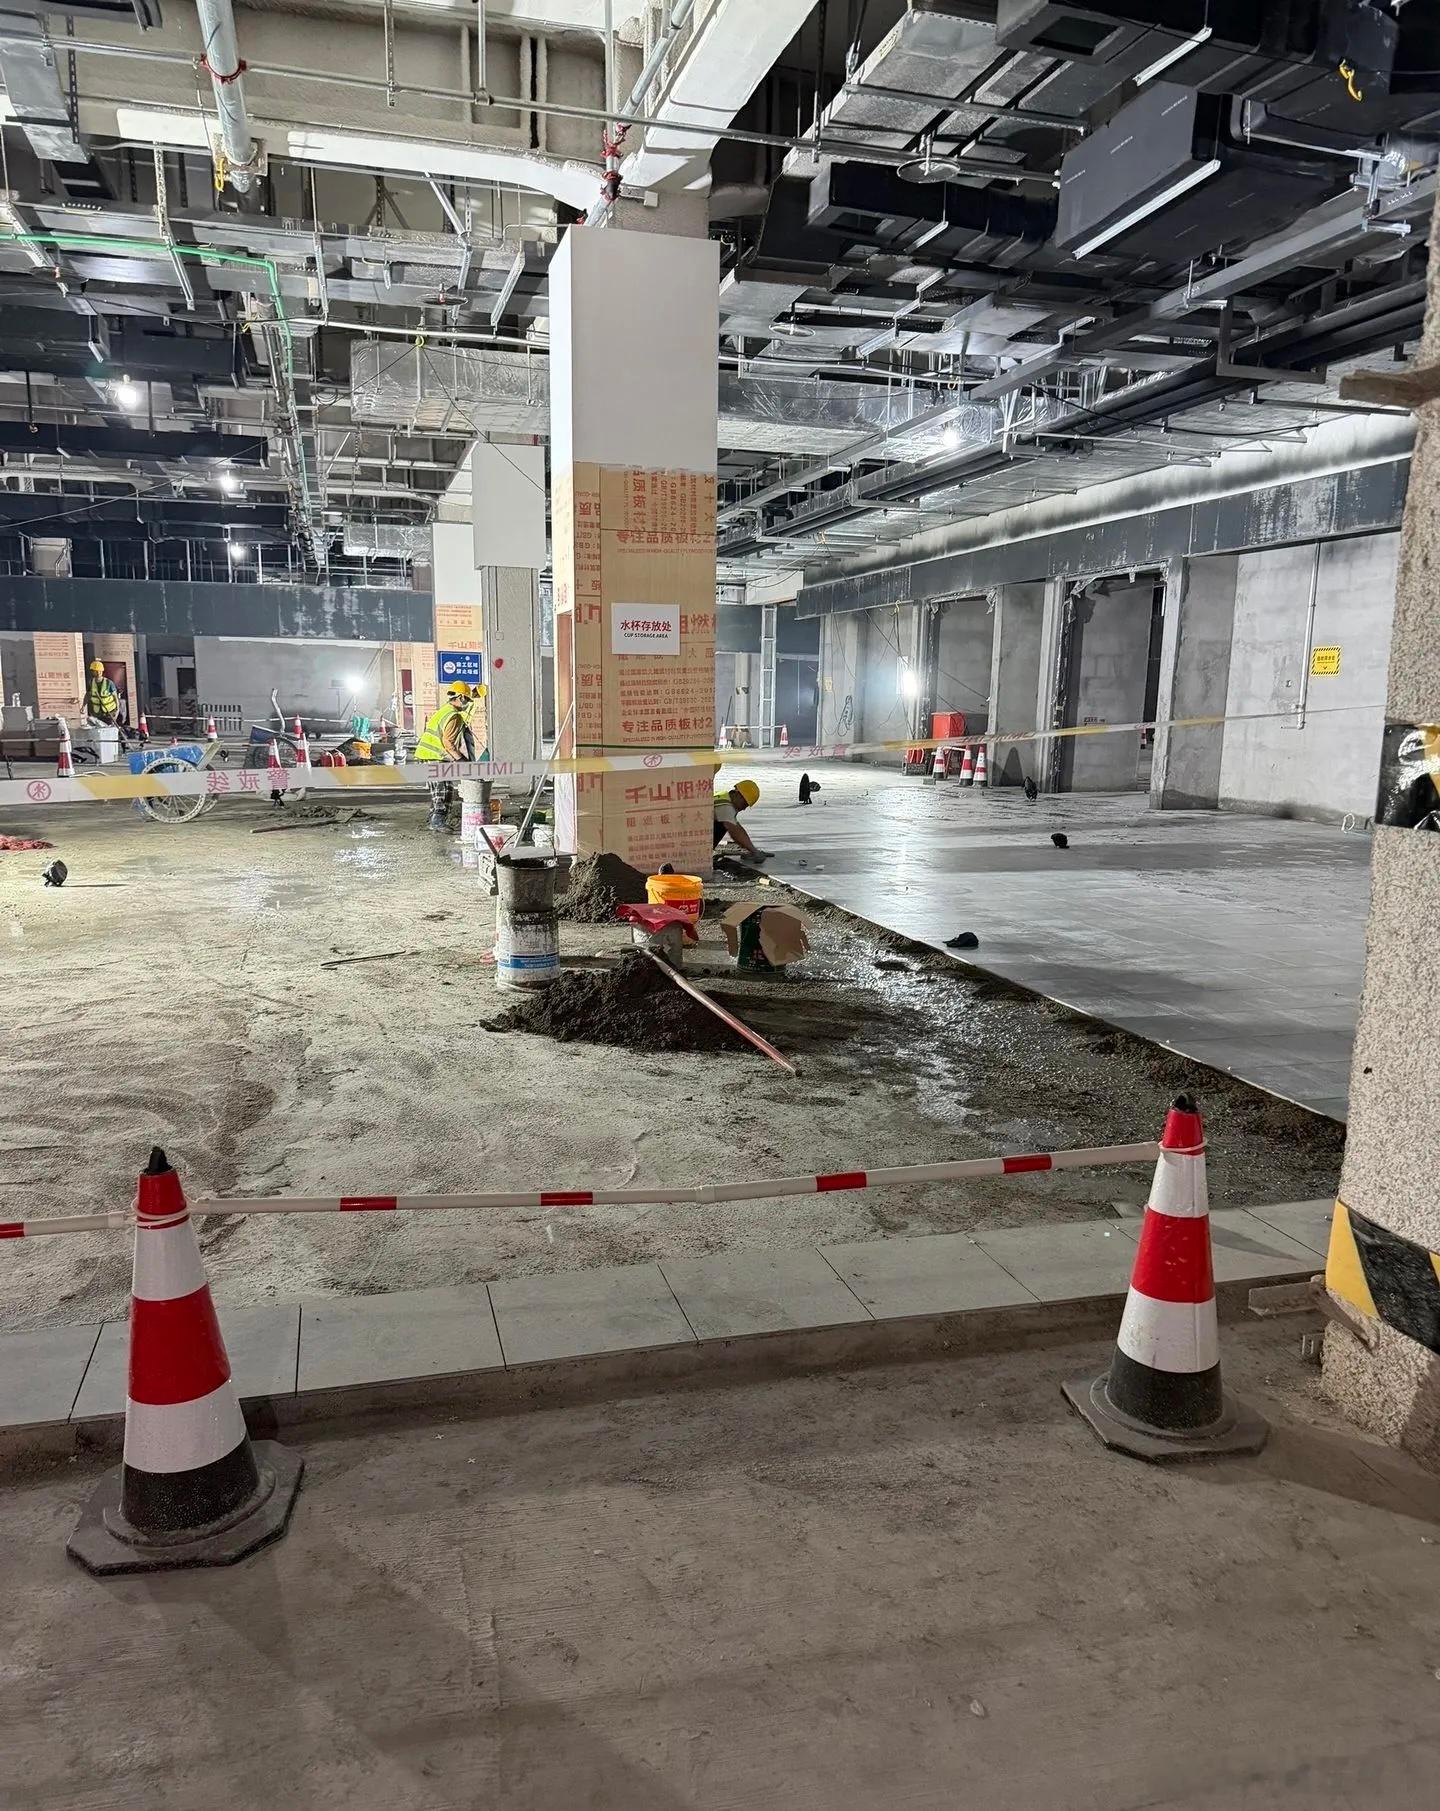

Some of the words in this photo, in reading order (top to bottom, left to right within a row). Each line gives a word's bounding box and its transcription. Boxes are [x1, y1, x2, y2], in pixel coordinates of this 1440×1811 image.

[620, 619, 672, 632] 水杯存放处
[622, 717, 712, 733] 专注品质板材2
